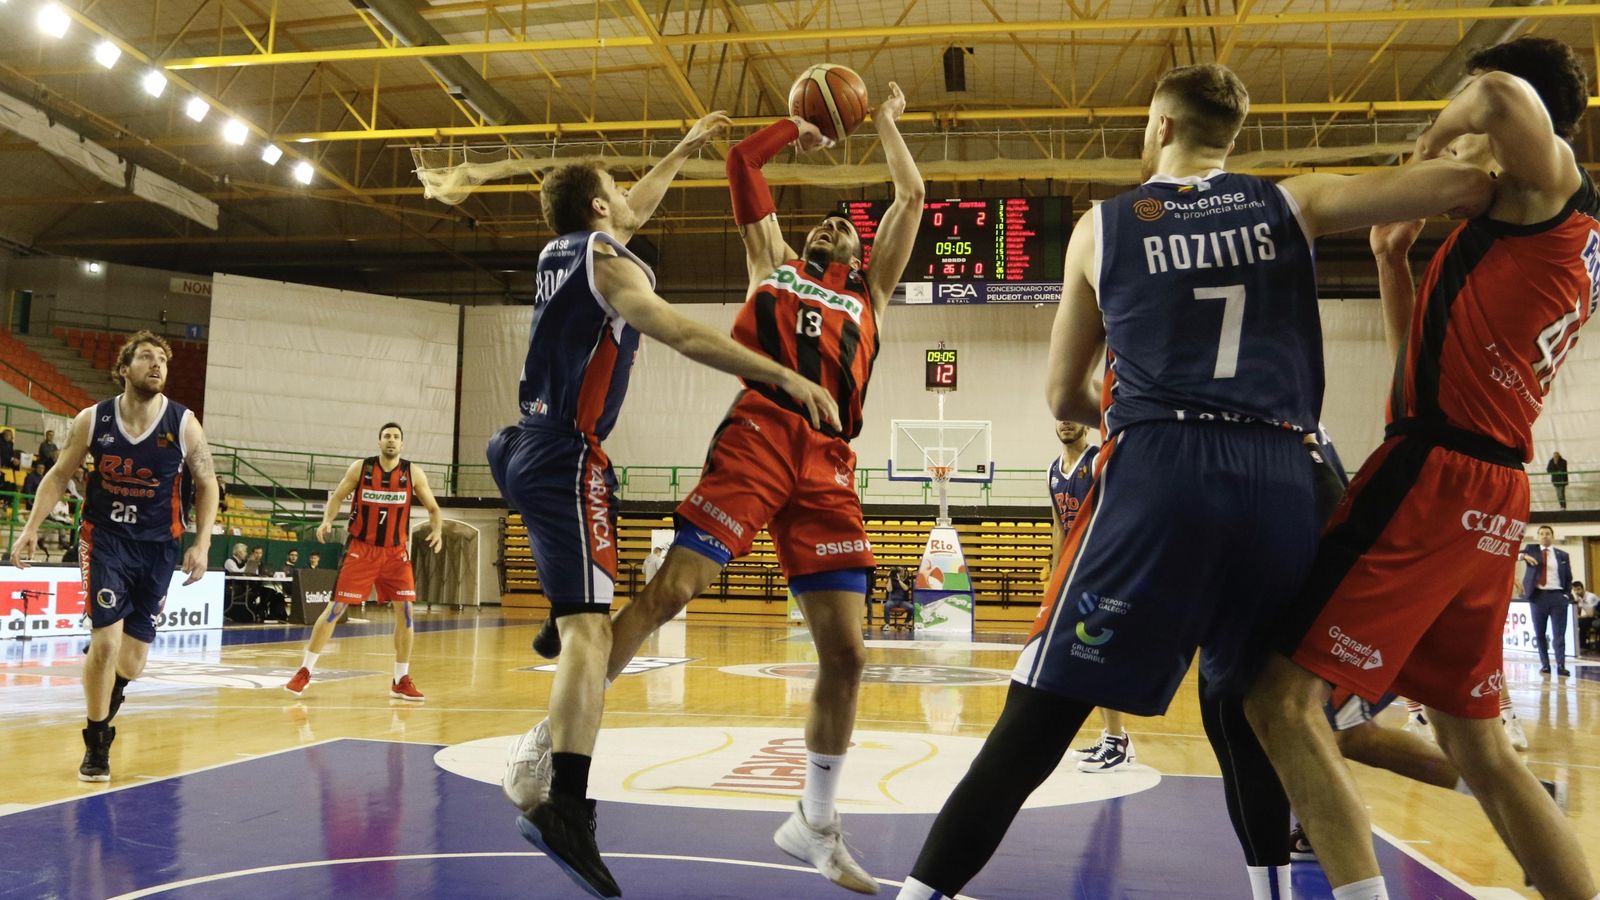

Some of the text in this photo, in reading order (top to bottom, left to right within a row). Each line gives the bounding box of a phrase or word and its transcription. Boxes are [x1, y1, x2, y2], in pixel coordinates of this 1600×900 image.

[934, 211, 986, 226] 0 2
[1183, 206, 1232, 221] provincia
[953, 225, 958, 235] 1
[935, 241, 972, 255] 09:05
[1143, 222, 1276, 275] ROZITIS
[943, 264, 955, 274] 26
[974, 262, 983, 274] 0
[938, 283, 978, 298] PSA
[795, 308, 823, 338] 13
[191, 326, 198, 337] 1
[1193, 284, 1246, 379] 7
[927, 351, 956, 362] 09:05
[936, 364, 954, 384] 12
[362, 491, 406, 501] COVIRAN
[110, 501, 137, 524] 26
[379, 511, 387, 524] 7
[815, 539, 865, 556] asisa
[930, 539, 954, 550] Rio
[1098, 603, 1127, 615] GALEGO
[1100, 596, 1131, 609] DEPORTE
[55, 618, 73, 628] &
[1328, 625, 1373, 657] Granada
[1072, 643, 1100, 655] GALICIA
[1330, 642, 1366, 668] Digital
[1070, 649, 1105, 664] SAUDABLE
